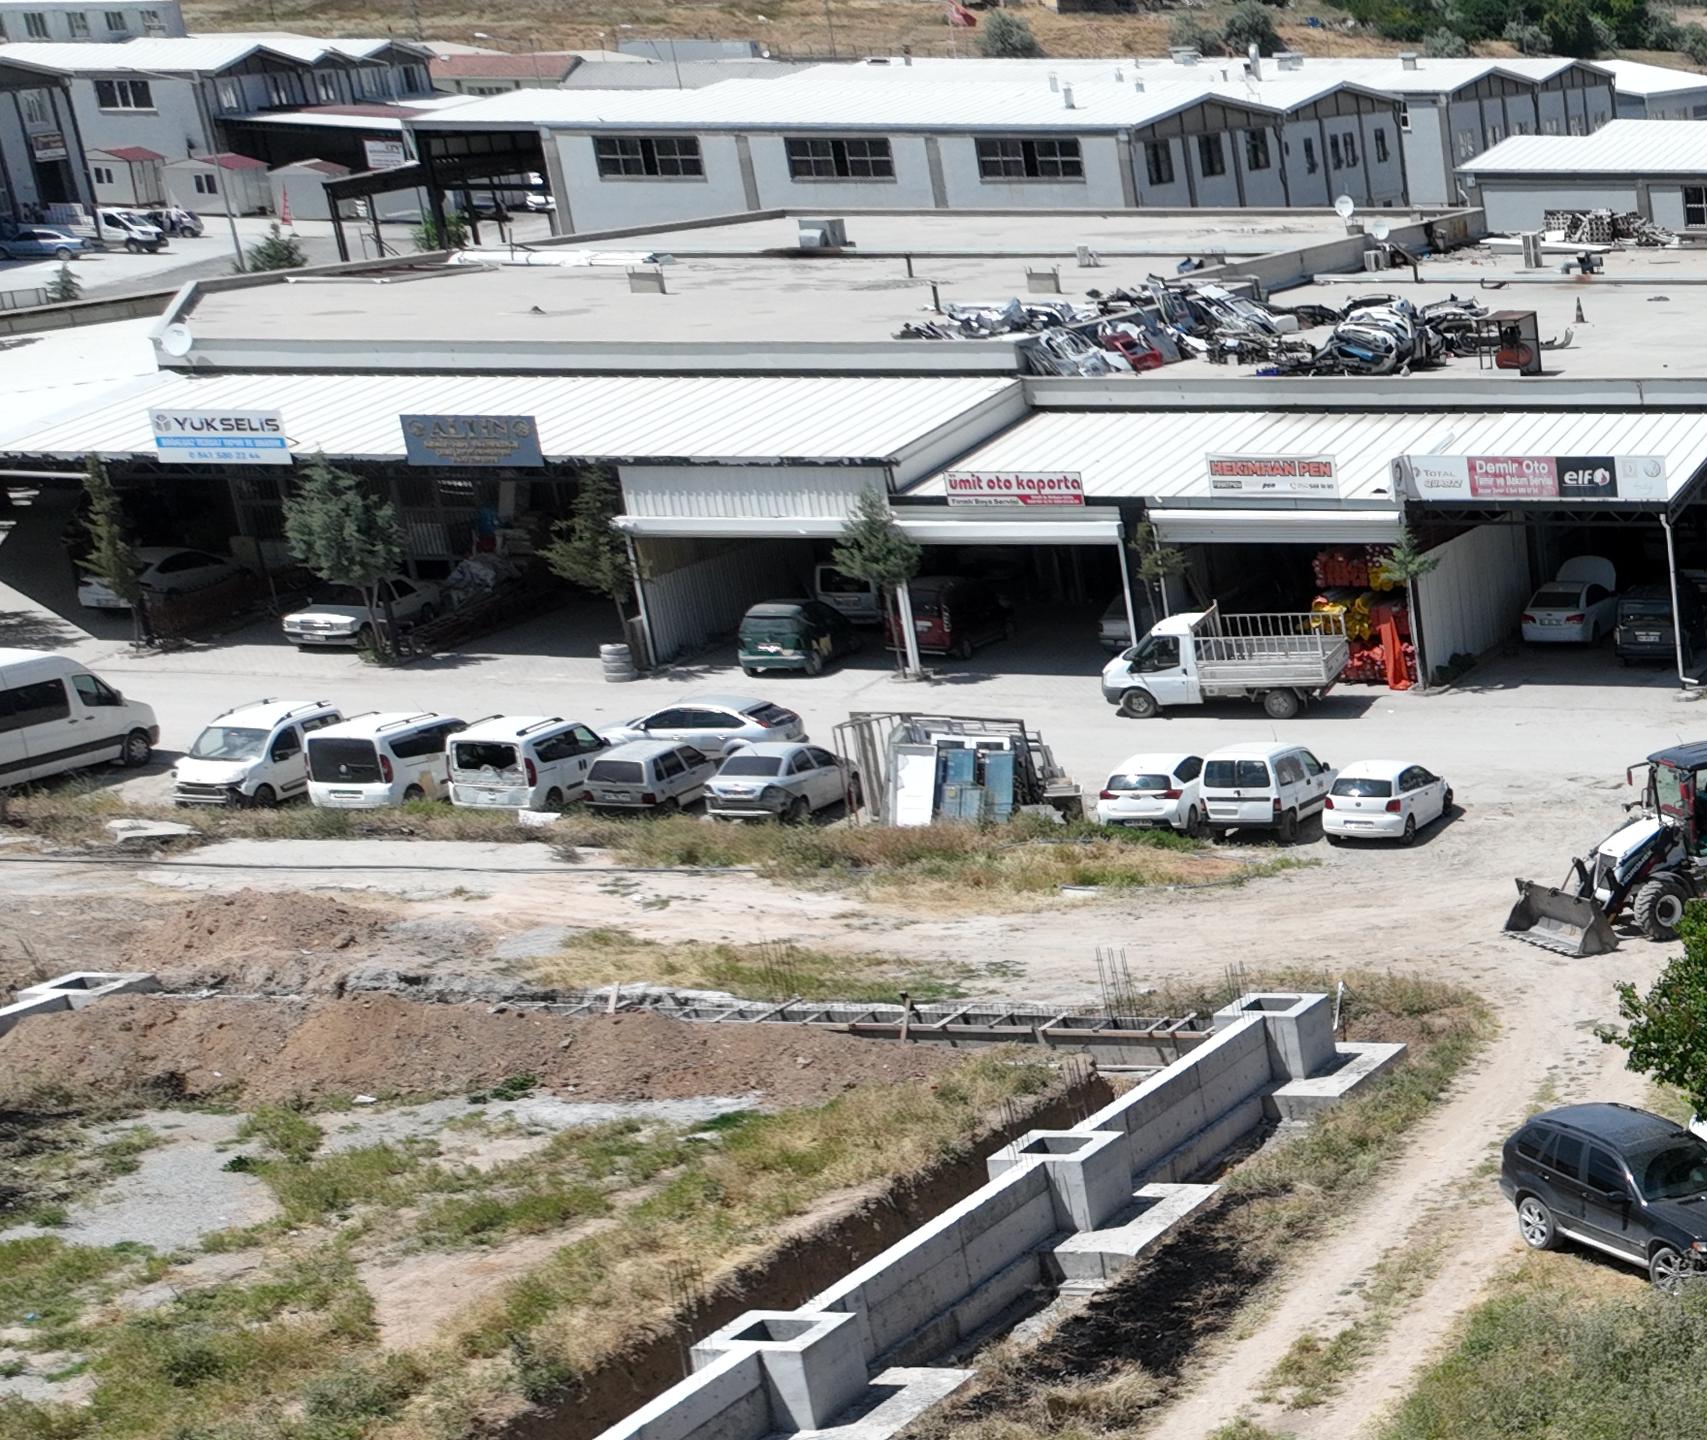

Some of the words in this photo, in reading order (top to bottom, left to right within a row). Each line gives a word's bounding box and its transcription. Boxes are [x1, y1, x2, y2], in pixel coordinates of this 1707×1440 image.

[1298, 461, 1332, 477] PEN
[1475, 460, 1518, 475] Demir
[1522, 460, 1549, 474] Oto
[987, 475, 1012, 490] oto
[1015, 475, 1081, 495] kaporta
[1564, 470, 1593, 485] elf
